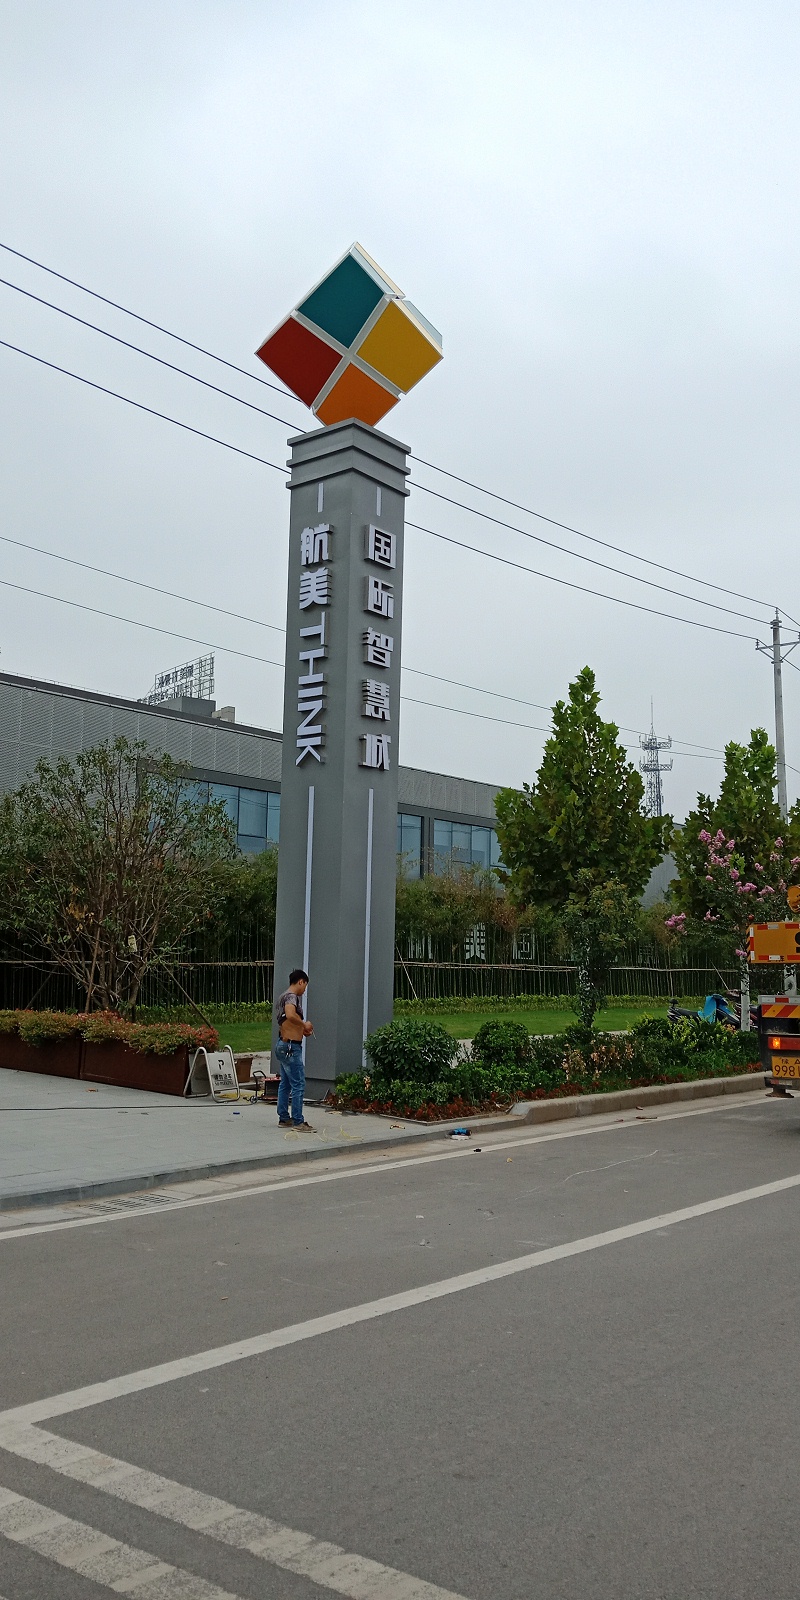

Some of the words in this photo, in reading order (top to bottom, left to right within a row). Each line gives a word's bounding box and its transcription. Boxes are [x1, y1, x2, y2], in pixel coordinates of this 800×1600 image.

[360, 523, 396, 770] 国际智慧城
[774, 1064, 800, 1077] 998
